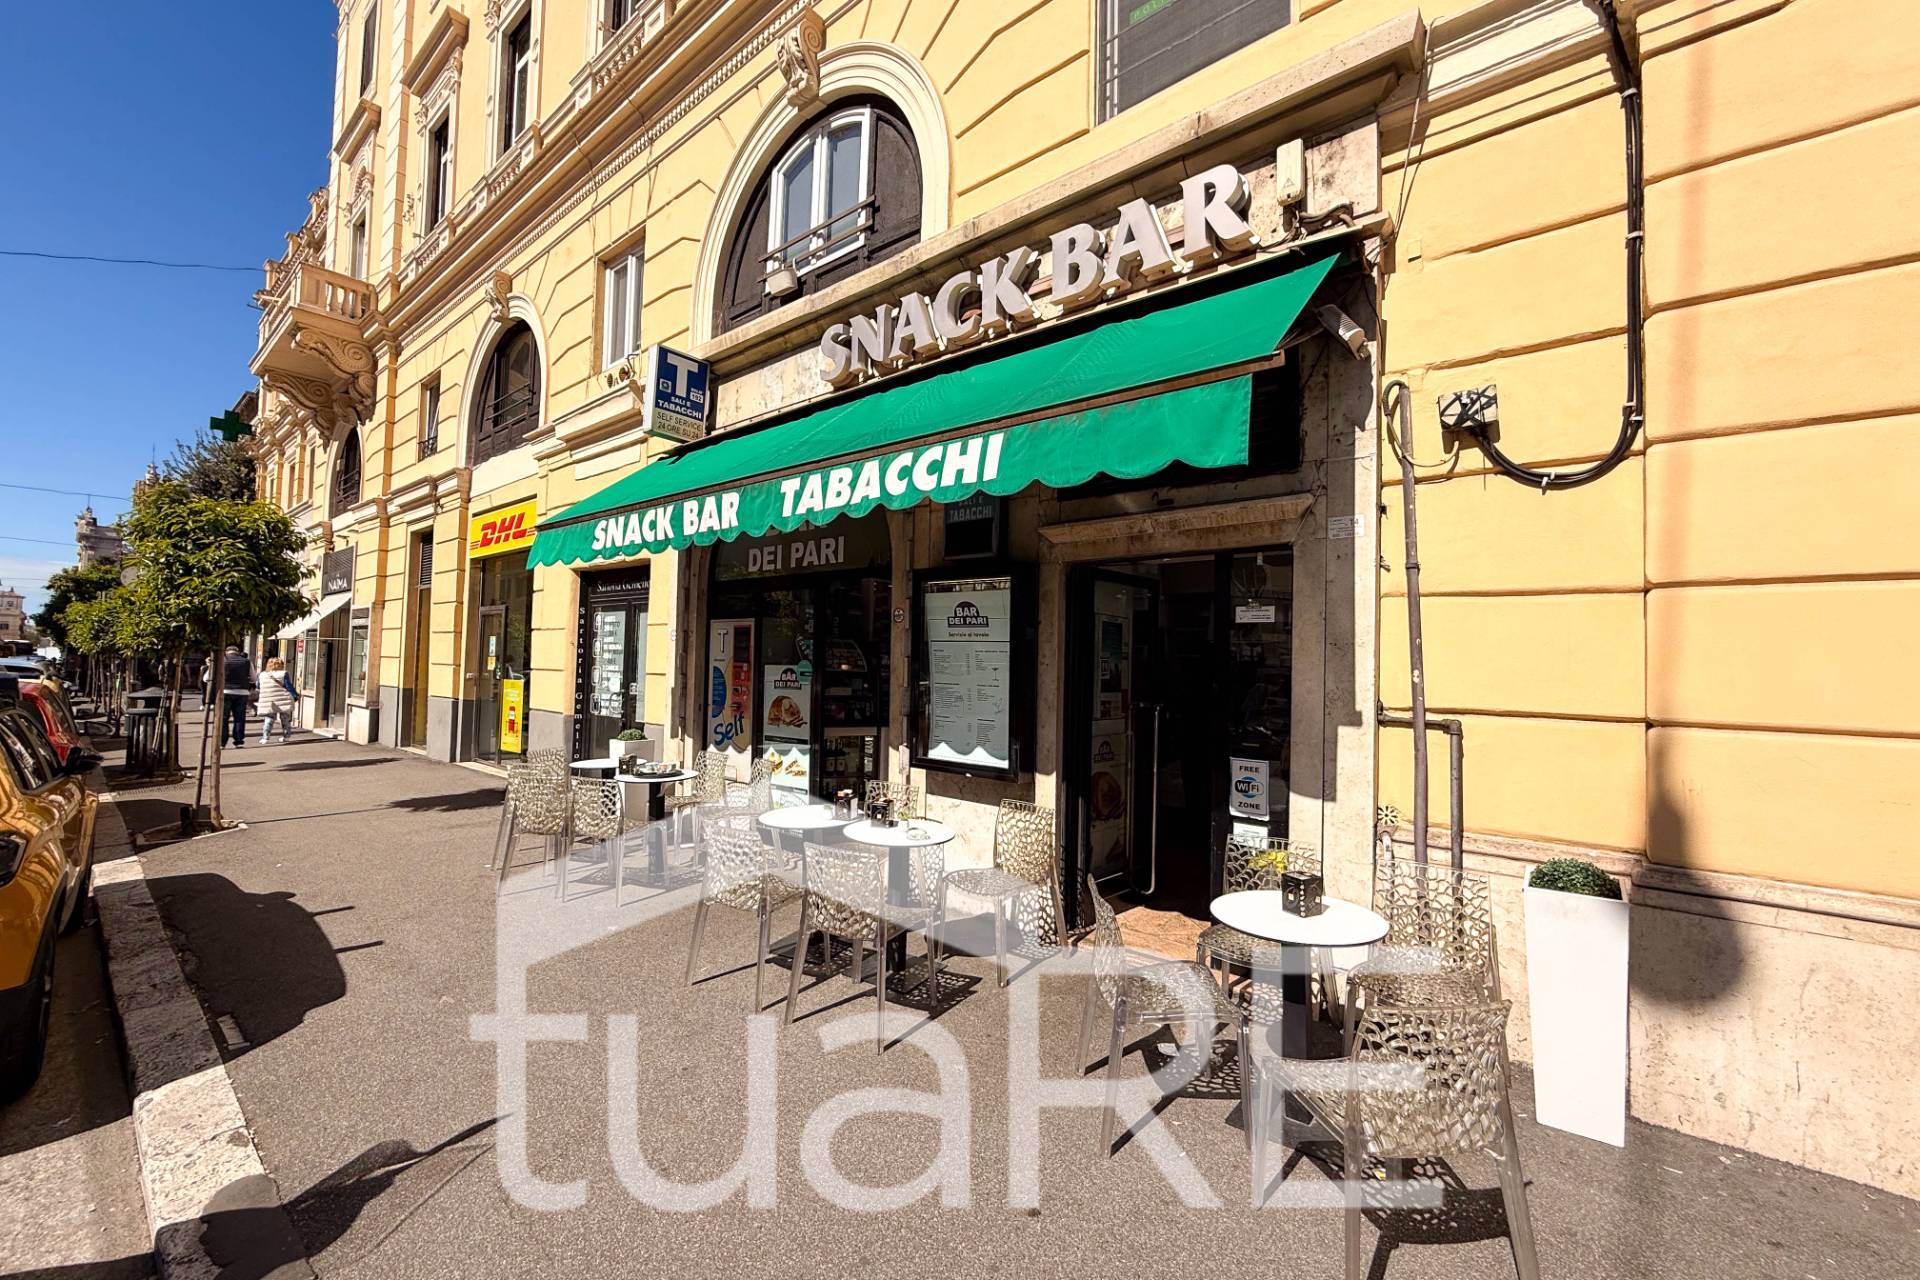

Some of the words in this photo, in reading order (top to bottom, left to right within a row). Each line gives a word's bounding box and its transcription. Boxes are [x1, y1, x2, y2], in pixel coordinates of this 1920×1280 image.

[820, 246, 1040, 387] SNACK
[1049, 164, 1261, 298] BAR
[667, 352, 698, 393] T
[657, 399, 702, 419] TABACCHI
[671, 396, 686, 405] SALI
[657, 411, 673, 421] SELF
[674, 416, 703, 431] SERVICE
[658, 421, 666, 429] 24
[667, 424, 680, 434] ORE
[682, 428, 691, 436] SU
[691, 431, 699, 439] 24
[592, 505, 675, 551] SNACK
[683, 492, 740, 536] BAR
[780, 432, 1005, 518] TABACCHI
[949, 506, 992, 522] TABACCHI
[480, 512, 528, 547] DHL
[748, 544, 783, 572] DEI
[790, 535, 845, 568] PARI
[949, 617, 964, 625] DEI
[966, 617, 987, 625] PARI
[956, 607, 978, 617] BAR
[577, 607, 586, 684] Sartoria
[718, 629, 728, 653] T
[574, 692, 583, 759] Gemello
[714, 712, 745, 746] Self
[1239, 765, 1260, 773] FREE
[1237, 782, 1259, 793] WiFi
[1238, 801, 1261, 810] ZONE
